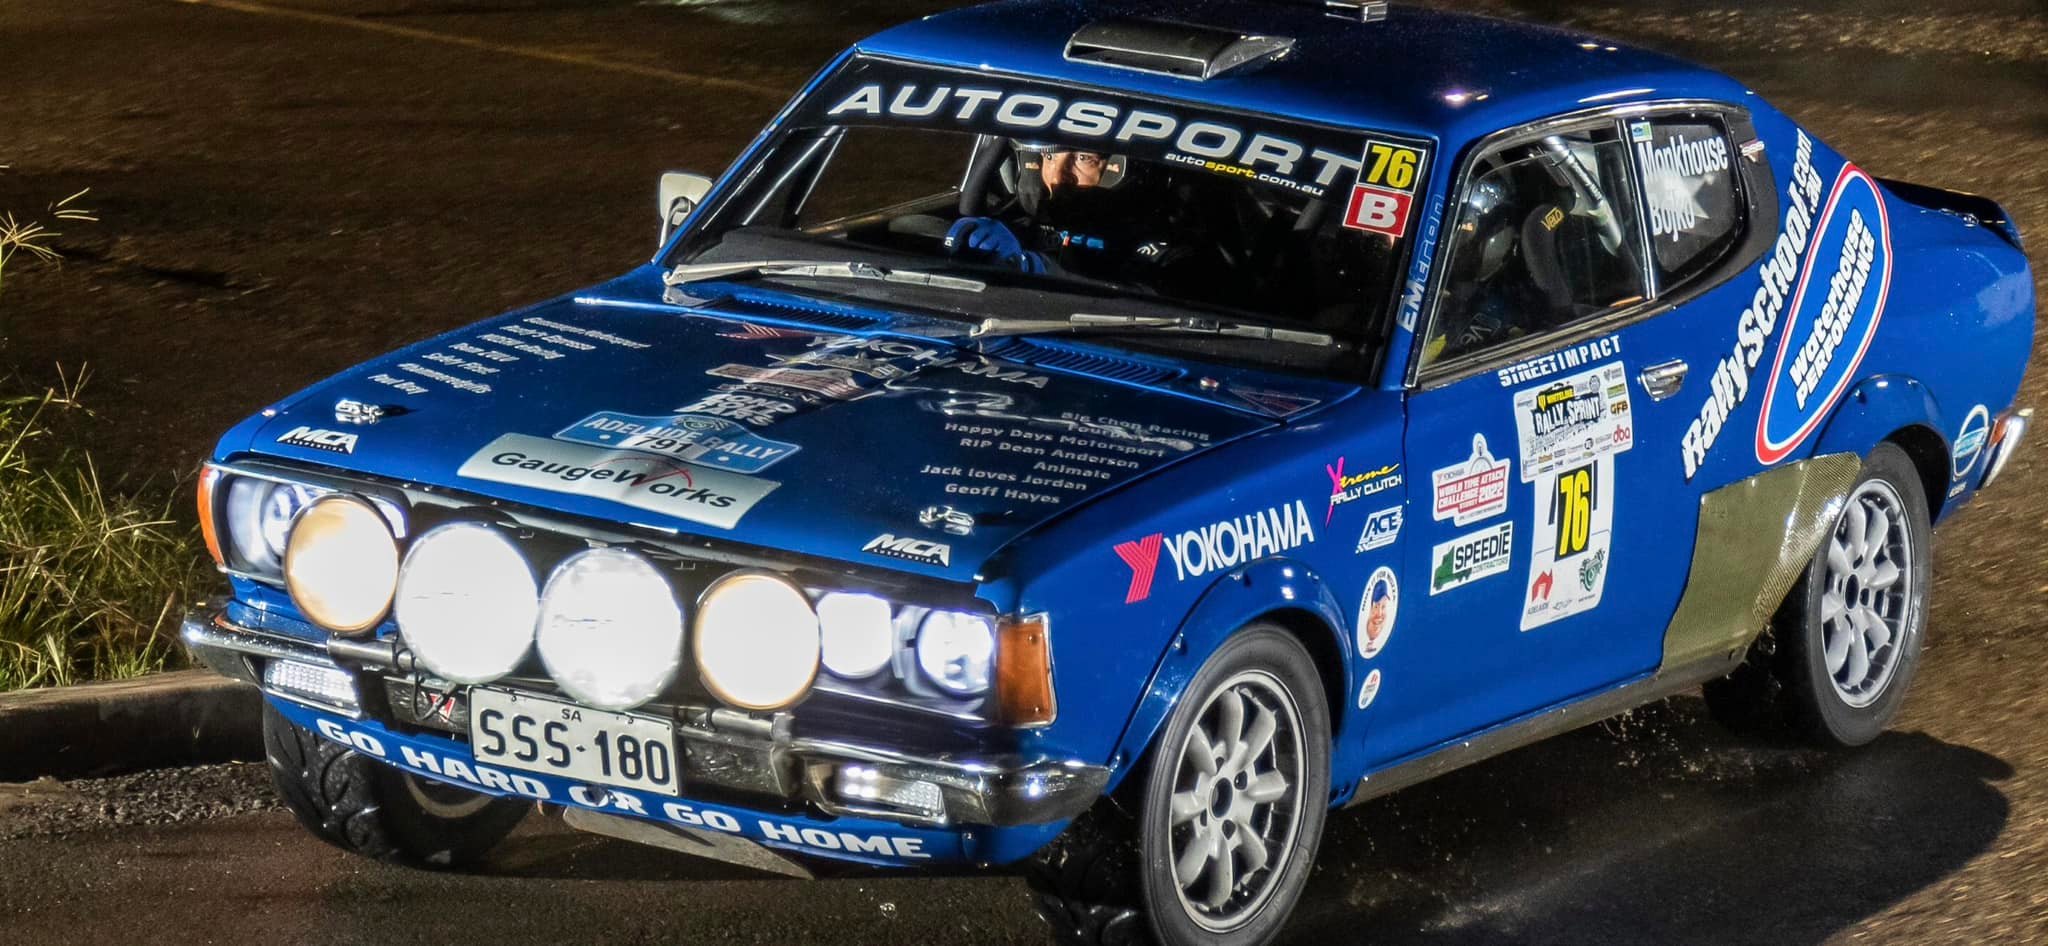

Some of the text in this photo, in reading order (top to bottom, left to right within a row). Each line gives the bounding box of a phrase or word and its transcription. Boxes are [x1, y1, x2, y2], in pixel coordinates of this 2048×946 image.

[828, 86, 1361, 186] AUTOSPORT
[1165, 152, 1324, 197] autosport.com.au
[1367, 145, 1417, 188] 76
[1638, 135, 1728, 178] Monkhouse
[1356, 192, 1400, 228] B
[1789, 208, 1864, 387] Waterhouse
[1795, 228, 1875, 411] PERFORMANCE
[1535, 396, 1601, 435] RALLY SPRINT
[277, 426, 358, 454] MCA
[584, 417, 783, 459] ADELAIDE RALLY
[634, 436, 693, 454] 791
[944, 422, 1004, 436] Happy
[1010, 429, 1053, 441] Days
[1059, 435, 1166, 457] Motorsport
[960, 438, 1140, 469] RIP Dean Anderson
[491, 452, 736, 508] GaugeWorks
[920, 464, 1087, 491] Jack loves Jordan
[1033, 461, 1111, 479] Animale
[945, 483, 1060, 503] Geoff Hayes
[1330, 474, 1402, 506] RALLY CLUTCH
[1363, 511, 1399, 541] ACE
[1559, 469, 1590, 556] 76
[862, 534, 950, 567] MCA
[1163, 500, 1314, 581] YOKOHAMA
[1455, 530, 1510, 570] SPEEDIE
[562, 708, 581, 722] SA
[317, 718, 931, 859] GO HARD OR GO HOME
